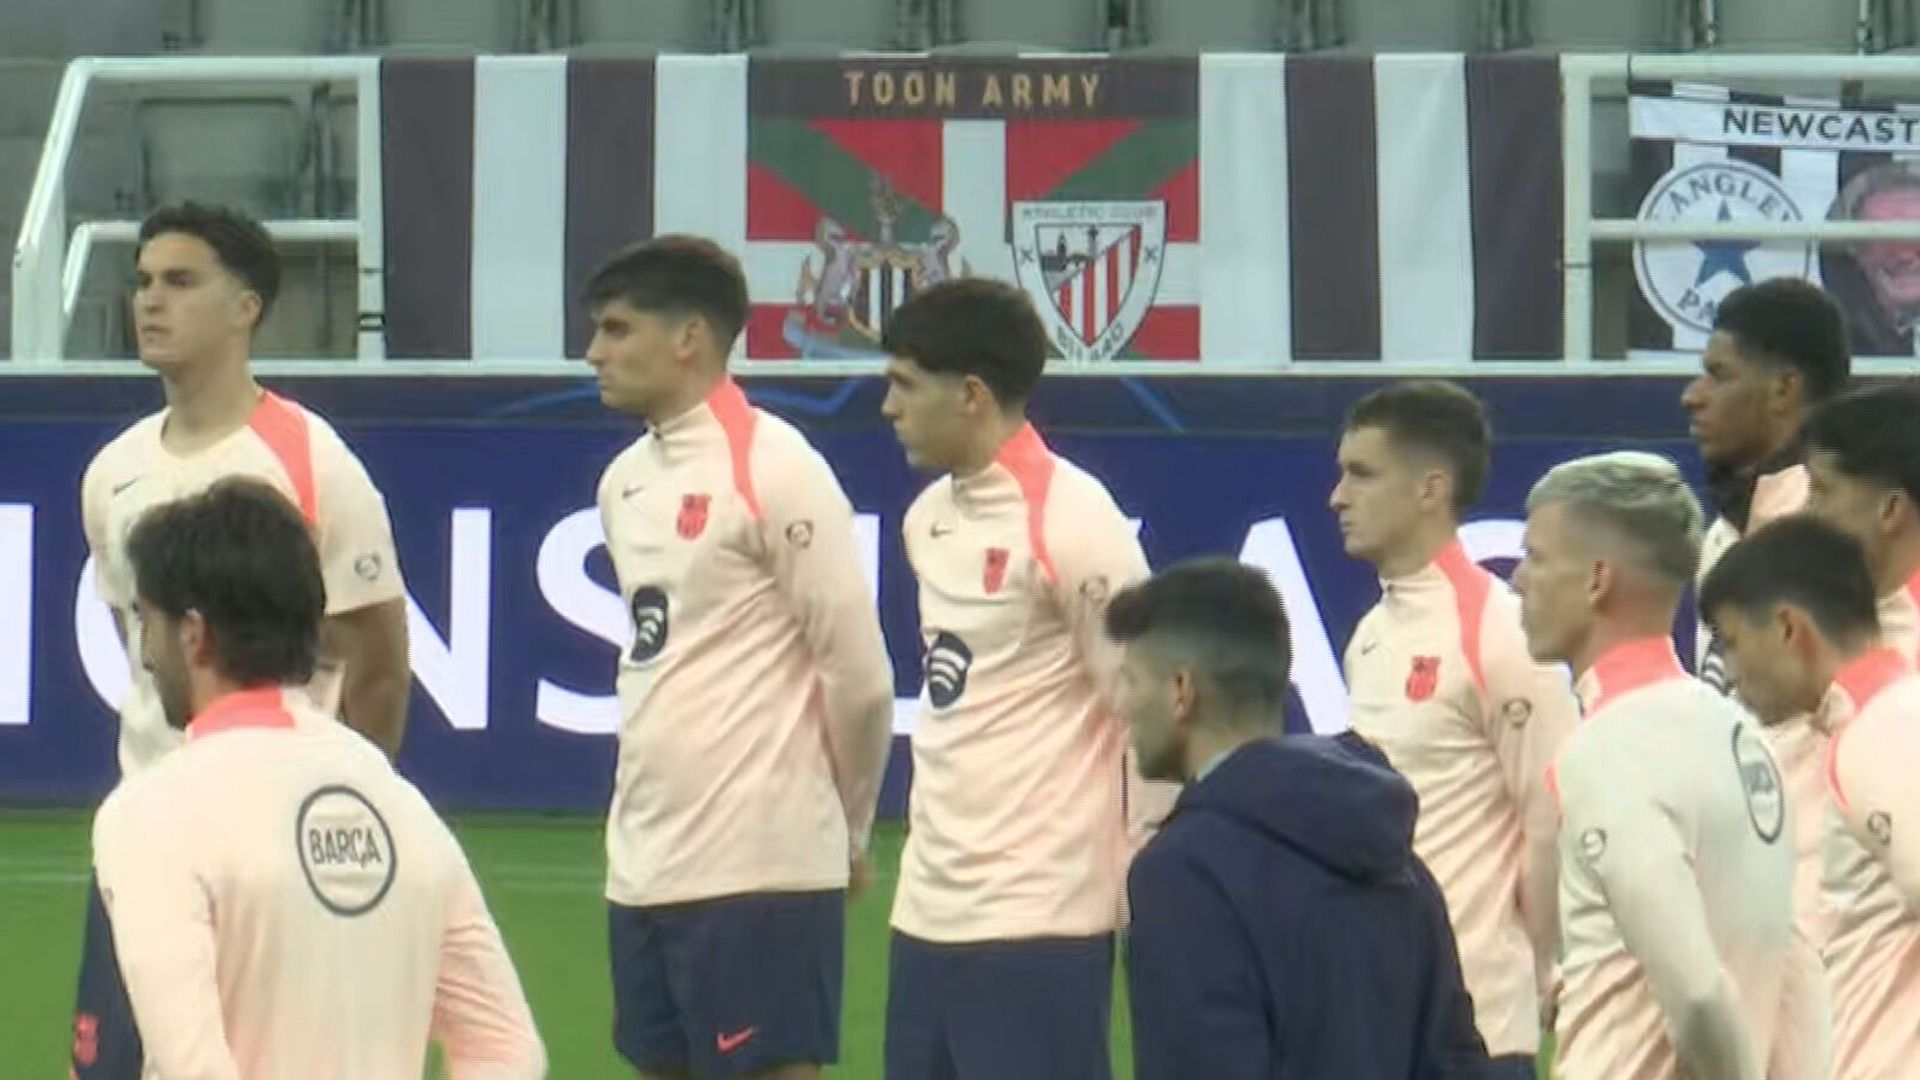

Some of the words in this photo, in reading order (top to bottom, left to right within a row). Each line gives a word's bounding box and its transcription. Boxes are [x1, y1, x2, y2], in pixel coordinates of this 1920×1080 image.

[844, 71, 956, 106] TOON
[982, 72, 1099, 107] ARMY
[308, 827, 382, 869] BARÇA
